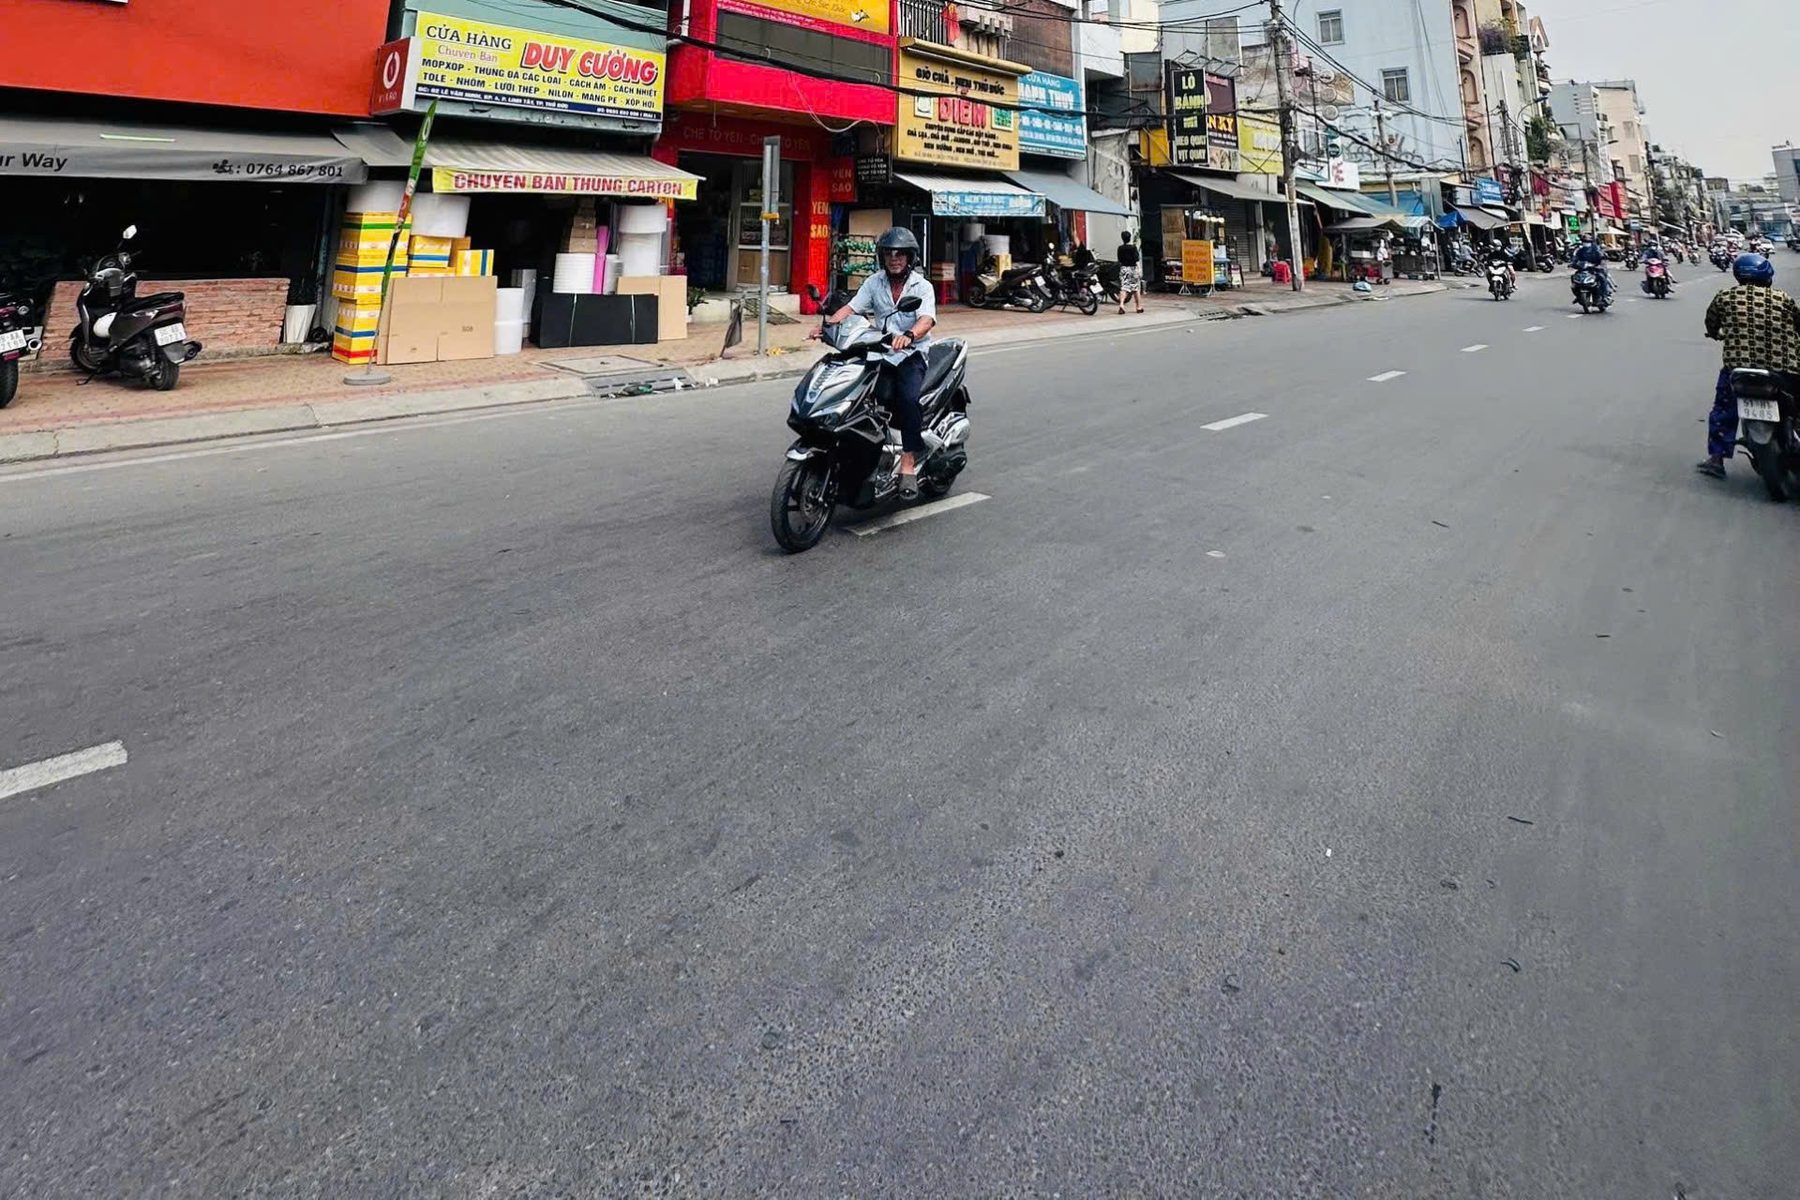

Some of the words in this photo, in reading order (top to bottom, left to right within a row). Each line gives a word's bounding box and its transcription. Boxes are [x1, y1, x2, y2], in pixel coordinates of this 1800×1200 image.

[521, 42, 576, 74] DUY
[548, 88, 574, 99] NILON
[22, 153, 68, 172] Way
[246, 163, 283, 176] 0764
[287, 164, 314, 176] 867
[318, 165, 343, 177] 801
[627, 180, 682, 195] CARTON
[831, 183, 852, 193] SAO
[810, 224, 829, 239] SAO
